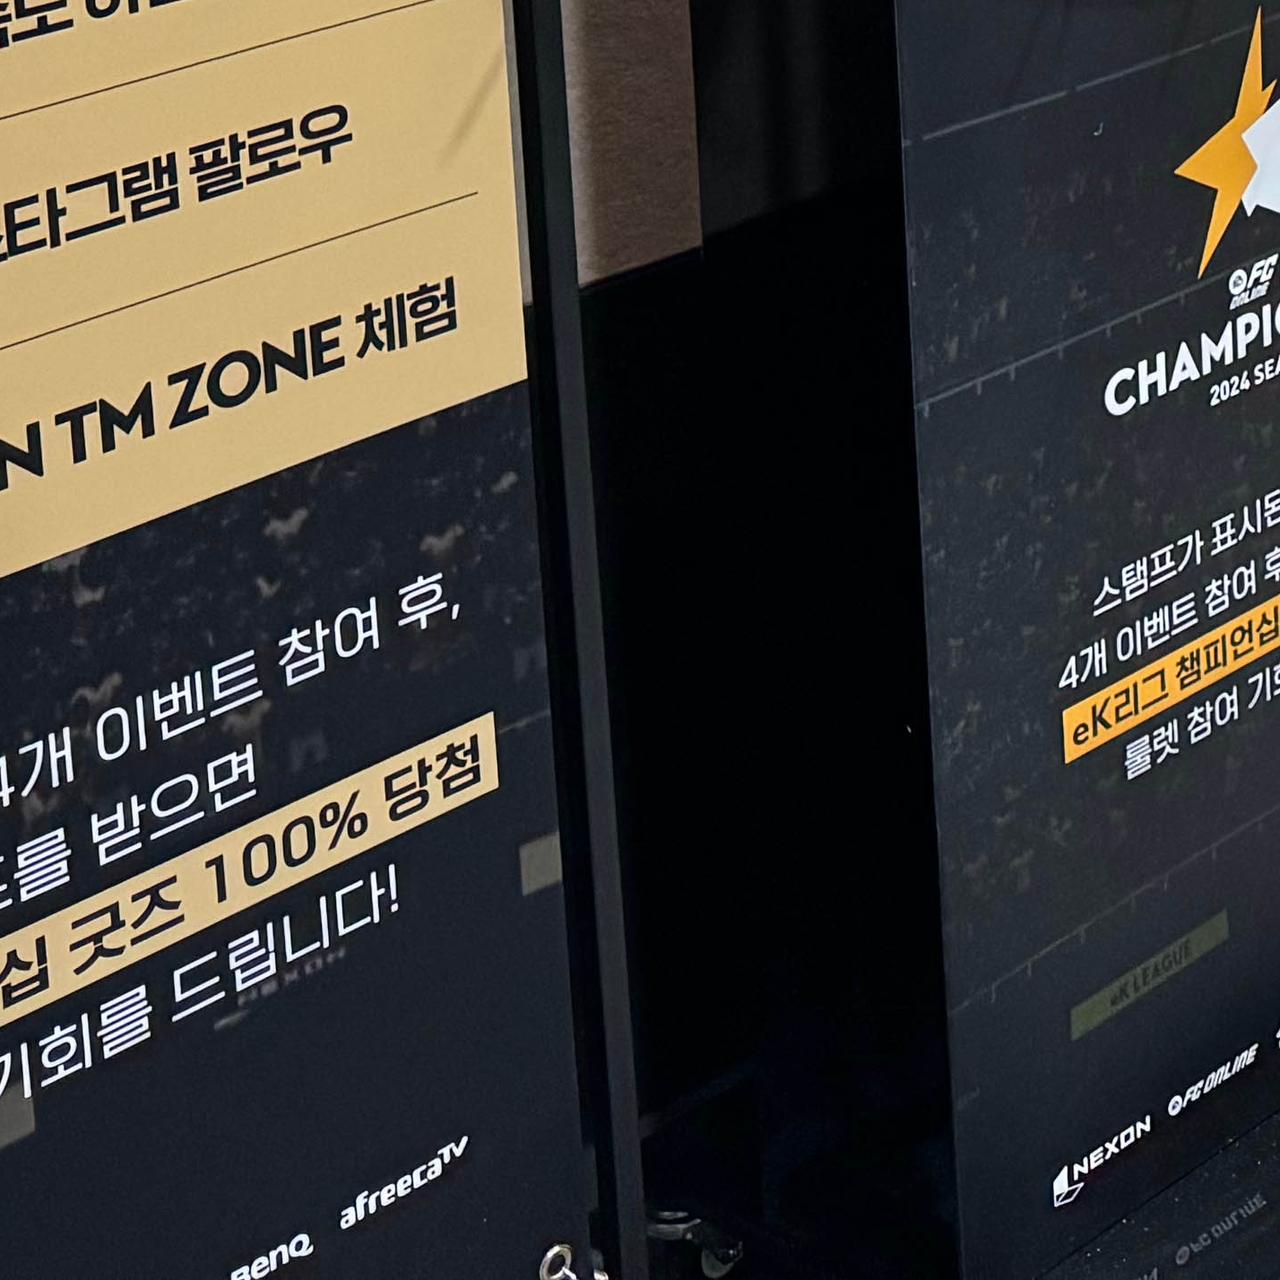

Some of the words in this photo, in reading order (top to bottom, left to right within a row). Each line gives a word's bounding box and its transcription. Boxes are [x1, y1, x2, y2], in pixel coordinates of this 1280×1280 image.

[0, 151, 180, 262] 타그램
[188, 104, 353, 203] 팔로우
[1247, 253, 1279, 289] FC
[54, 380, 155, 465] TM
[167, 315, 346, 430] ZONE
[355, 275, 458, 360] 체험
[1209, 370, 1251, 407] 2024
[1059, 635, 1108, 689] 4개
[1116, 592, 1198, 662] 이벤트
[1204, 563, 1257, 618] 참여
[1093, 530, 1201, 616] 스탬프가
[95, 649, 263, 762] 이벤트
[277, 596, 381, 686] 참여
[397, 572, 461, 630] 후,
[1072, 668, 1169, 745] eK리그
[1175, 602, 1280, 688] 챔피언십
[1124, 718, 1180, 781] 룰렛
[1187, 686, 1239, 743] 참여
[91, 743, 257, 866] 받으면
[0, 935, 49, 1008] 십
[71, 874, 185, 975] 굿즈
[204, 791, 368, 903] 100%
[383, 734, 481, 821] 당첨
[0, 983, 153, 1100] 기회를
[171, 863, 400, 1022] 드립니다!
[1072, 1115, 1152, 1181] NEXON
